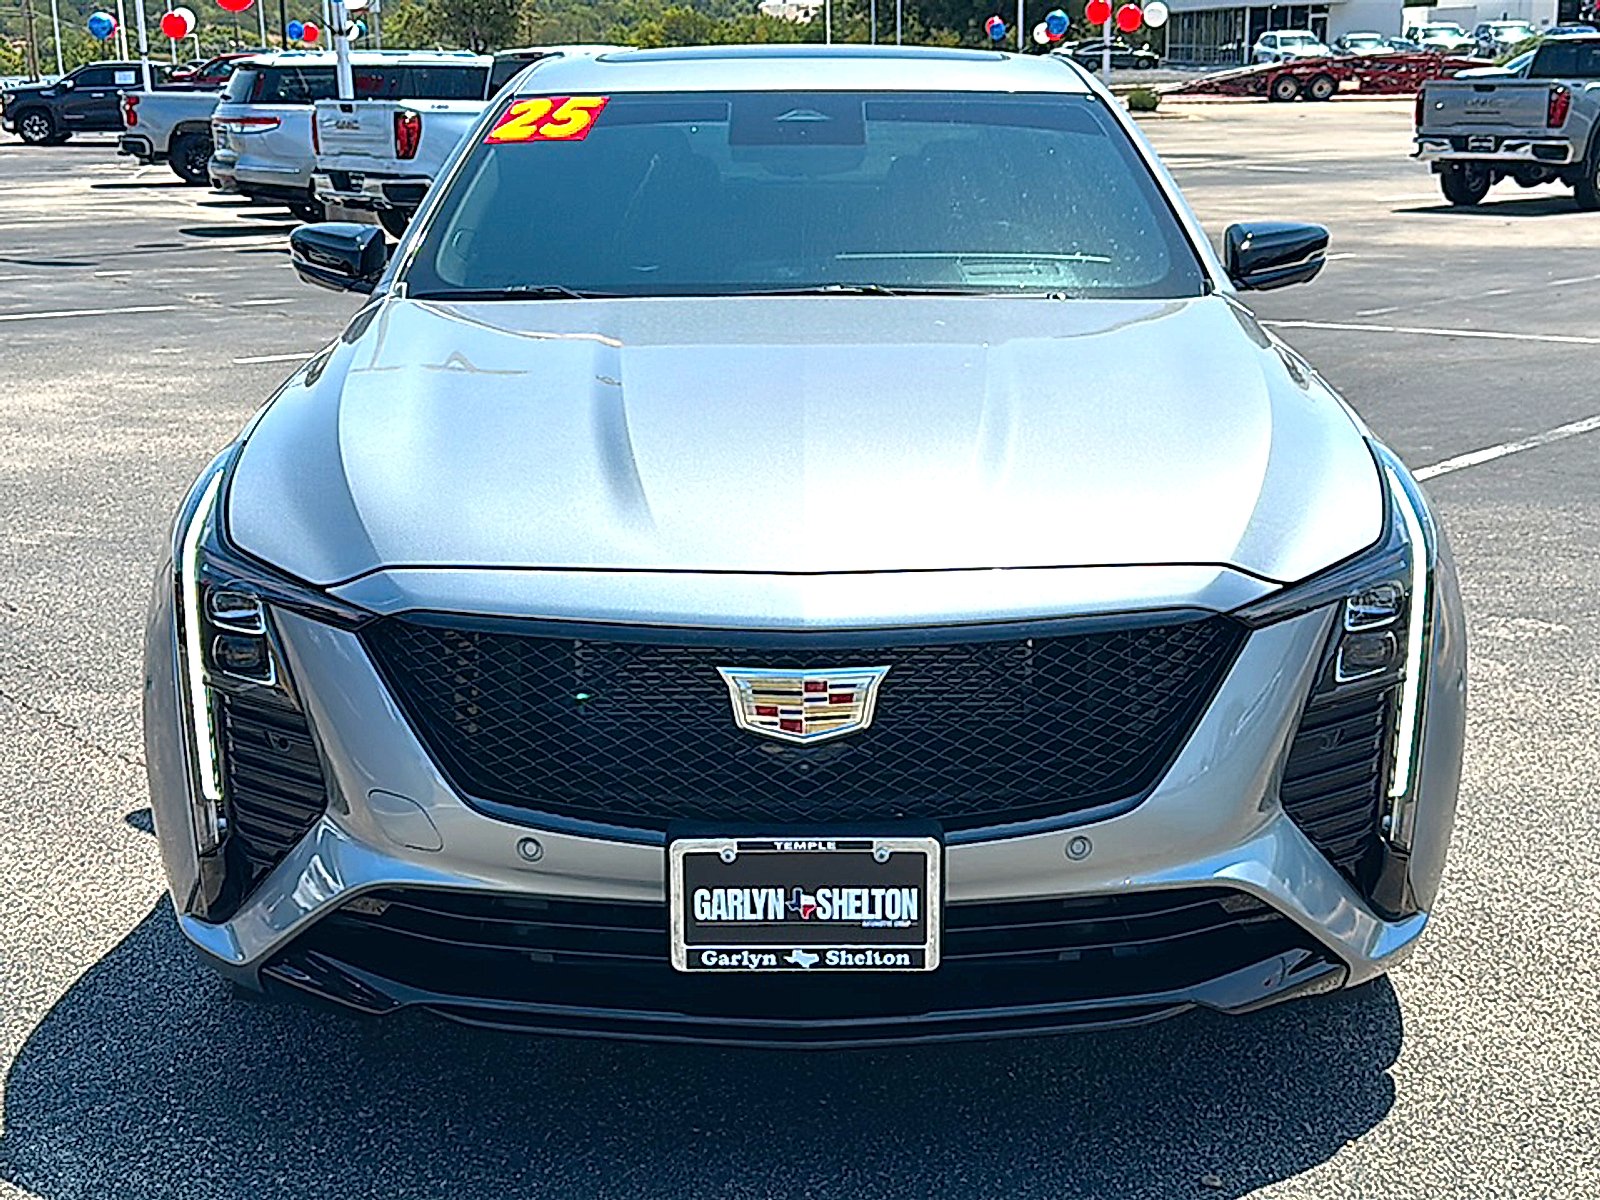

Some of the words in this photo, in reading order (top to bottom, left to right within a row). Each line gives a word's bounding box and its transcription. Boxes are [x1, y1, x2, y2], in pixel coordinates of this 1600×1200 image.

[491, 96, 603, 139] 25
[773, 841, 837, 851] TEMPLE
[694, 888, 784, 920] GARLYN
[816, 888, 918, 920] SHELTON
[701, 951, 778, 969] Garlyn
[825, 950, 911, 967] Shelton
